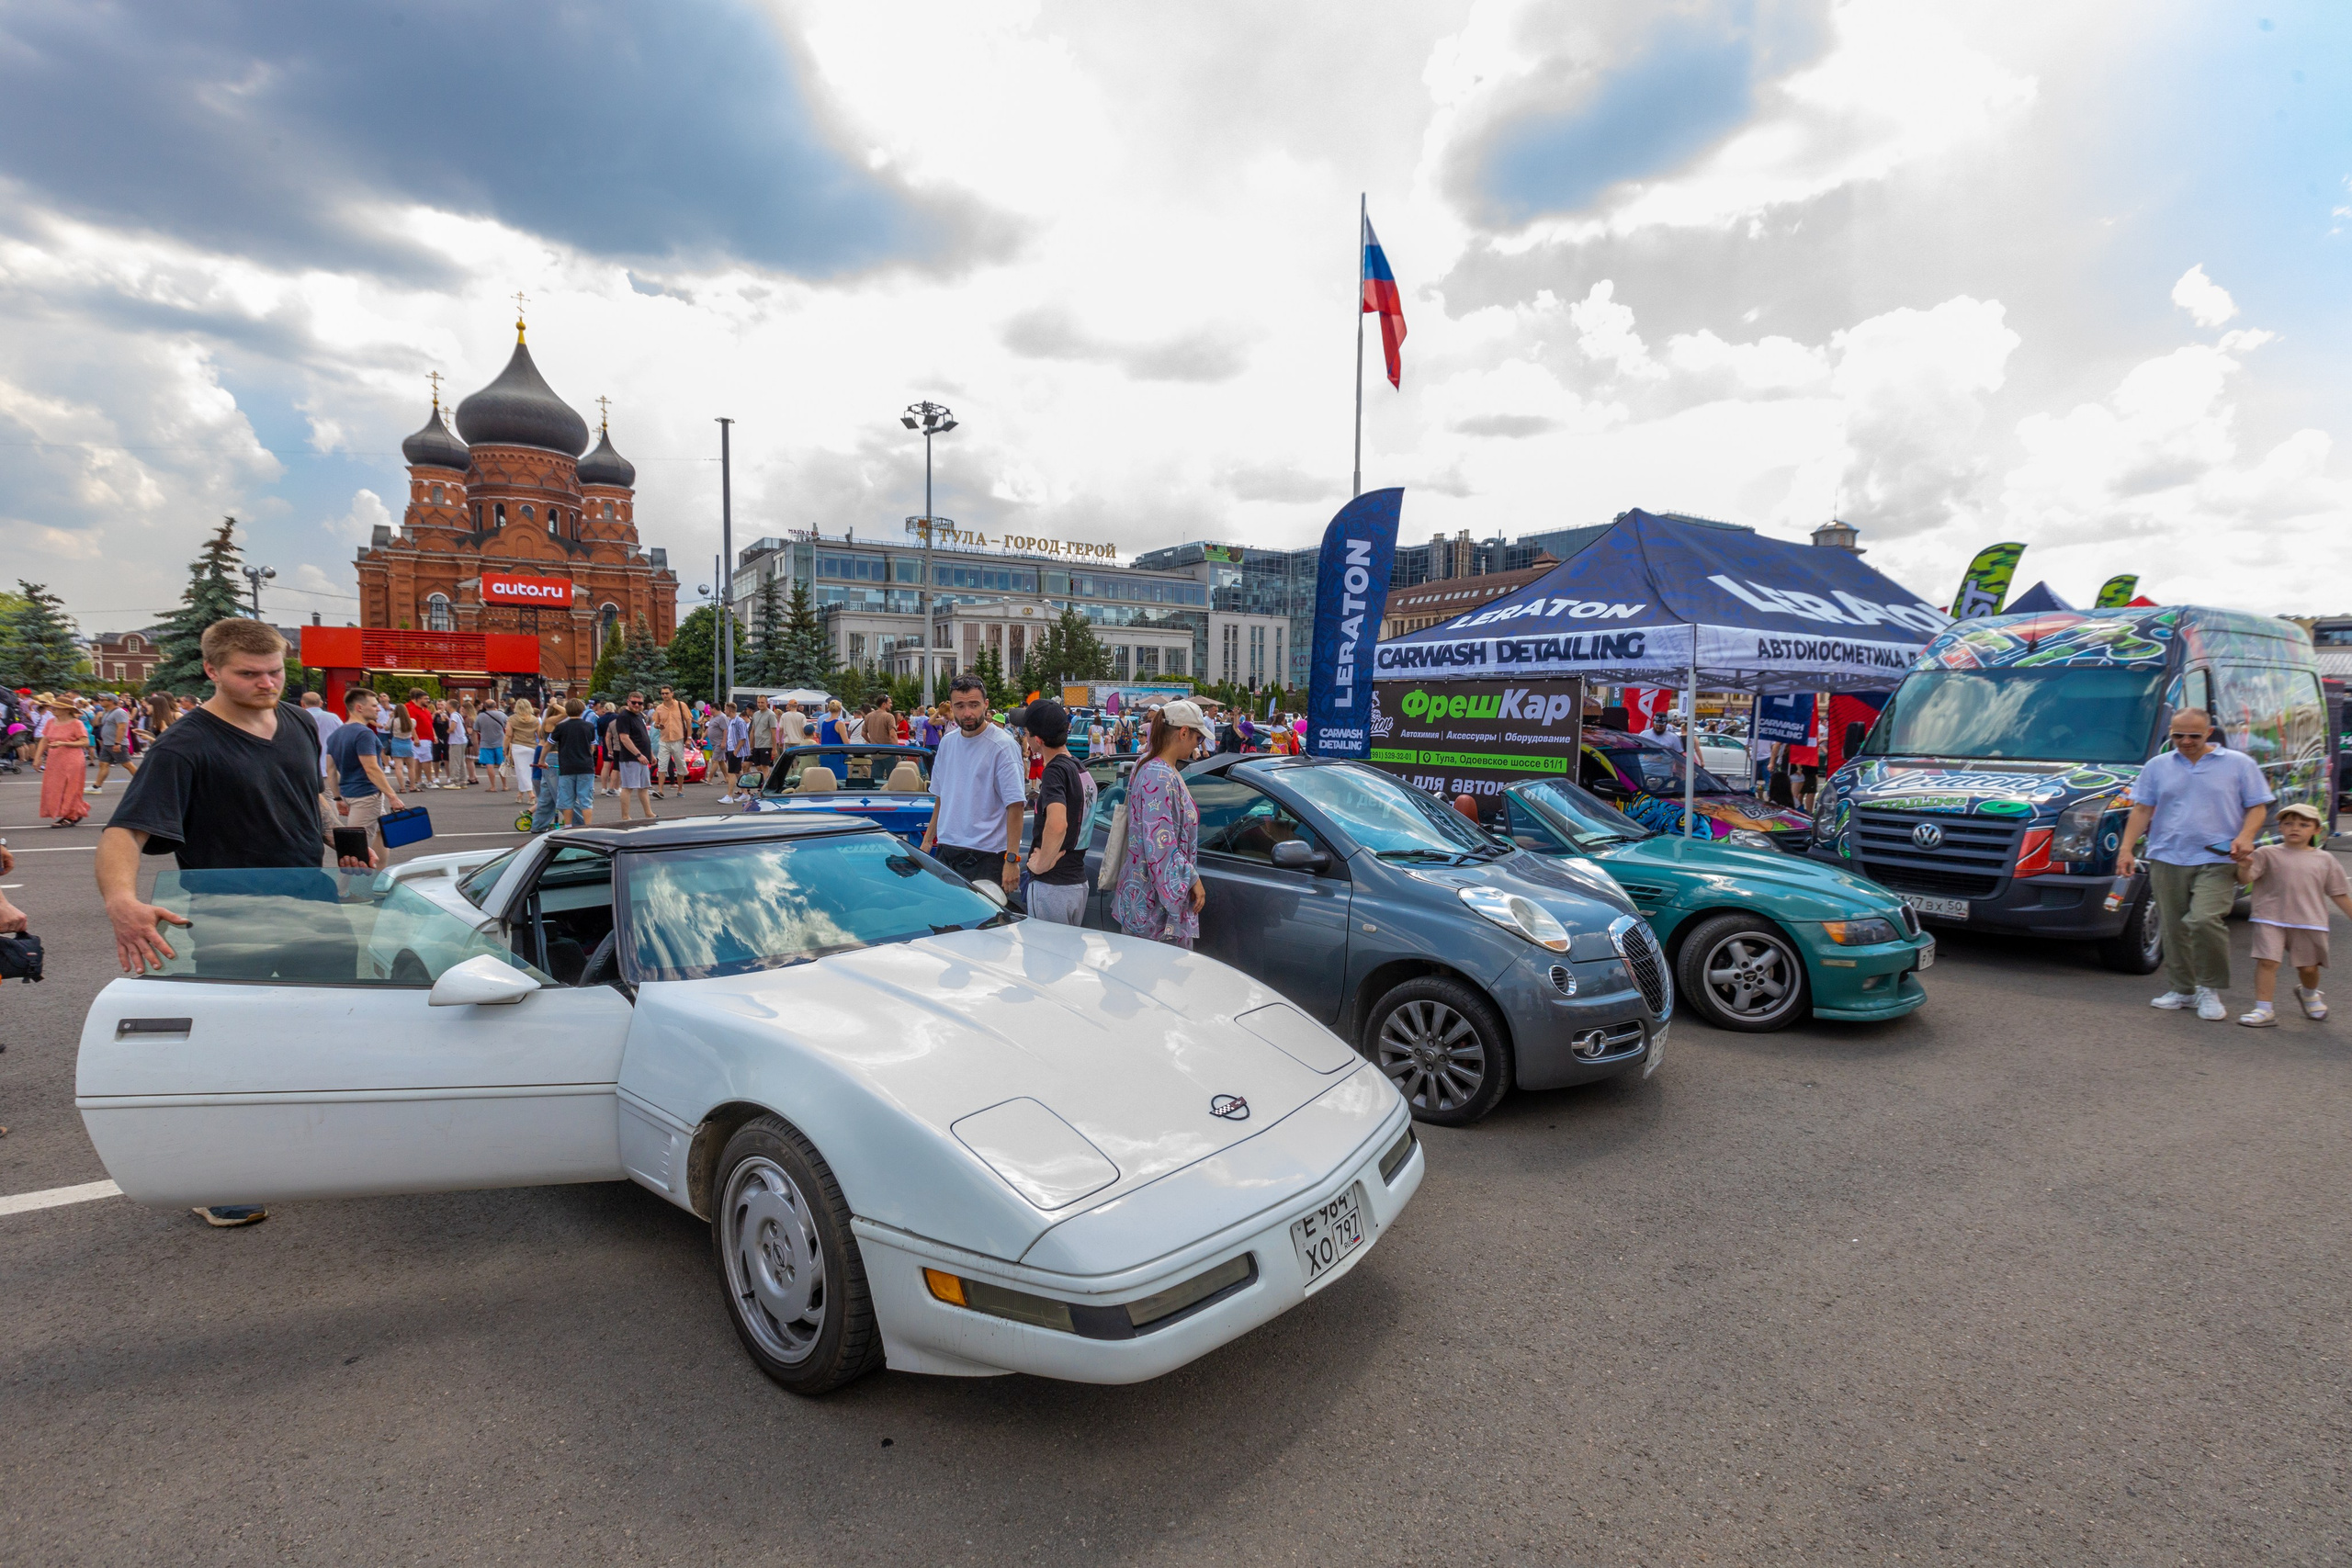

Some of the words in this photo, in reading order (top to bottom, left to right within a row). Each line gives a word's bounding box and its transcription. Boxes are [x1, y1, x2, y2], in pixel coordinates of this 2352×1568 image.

[938, 528, 987, 546] ТУЛА
[1004, 535, 1116, 558] ГОРОД-ГЕРОЙ
[492, 582, 563, 598] auto.ru
[1334, 538, 1372, 708] LERATON
[1445, 598, 1647, 630] LERATON
[1378, 642, 1487, 670] CARWASH
[1497, 631, 1646, 664] DETAILING
[1758, 637, 1906, 669] АВТОКОСМЕТИКА
[1401, 688, 1572, 727] ФрешКар
[1319, 728, 1363, 739] CARWASH
[1758, 717, 1805, 731] CARWASH
[1318, 739, 1363, 750] DETAILING
[1400, 728, 1440, 739] Автохимия
[1446, 730, 1497, 742] Аксессуары
[1504, 732, 1571, 745] Оборудование
[1435, 753, 1457, 764] Тула,
[1459, 754, 1509, 767] Одоевское
[1510, 760, 1541, 768] шоссе
[1544, 759, 1563, 770] 61/1
[1335, 1213, 1358, 1246] 797
[1344, 1238, 1354, 1250] RUS
